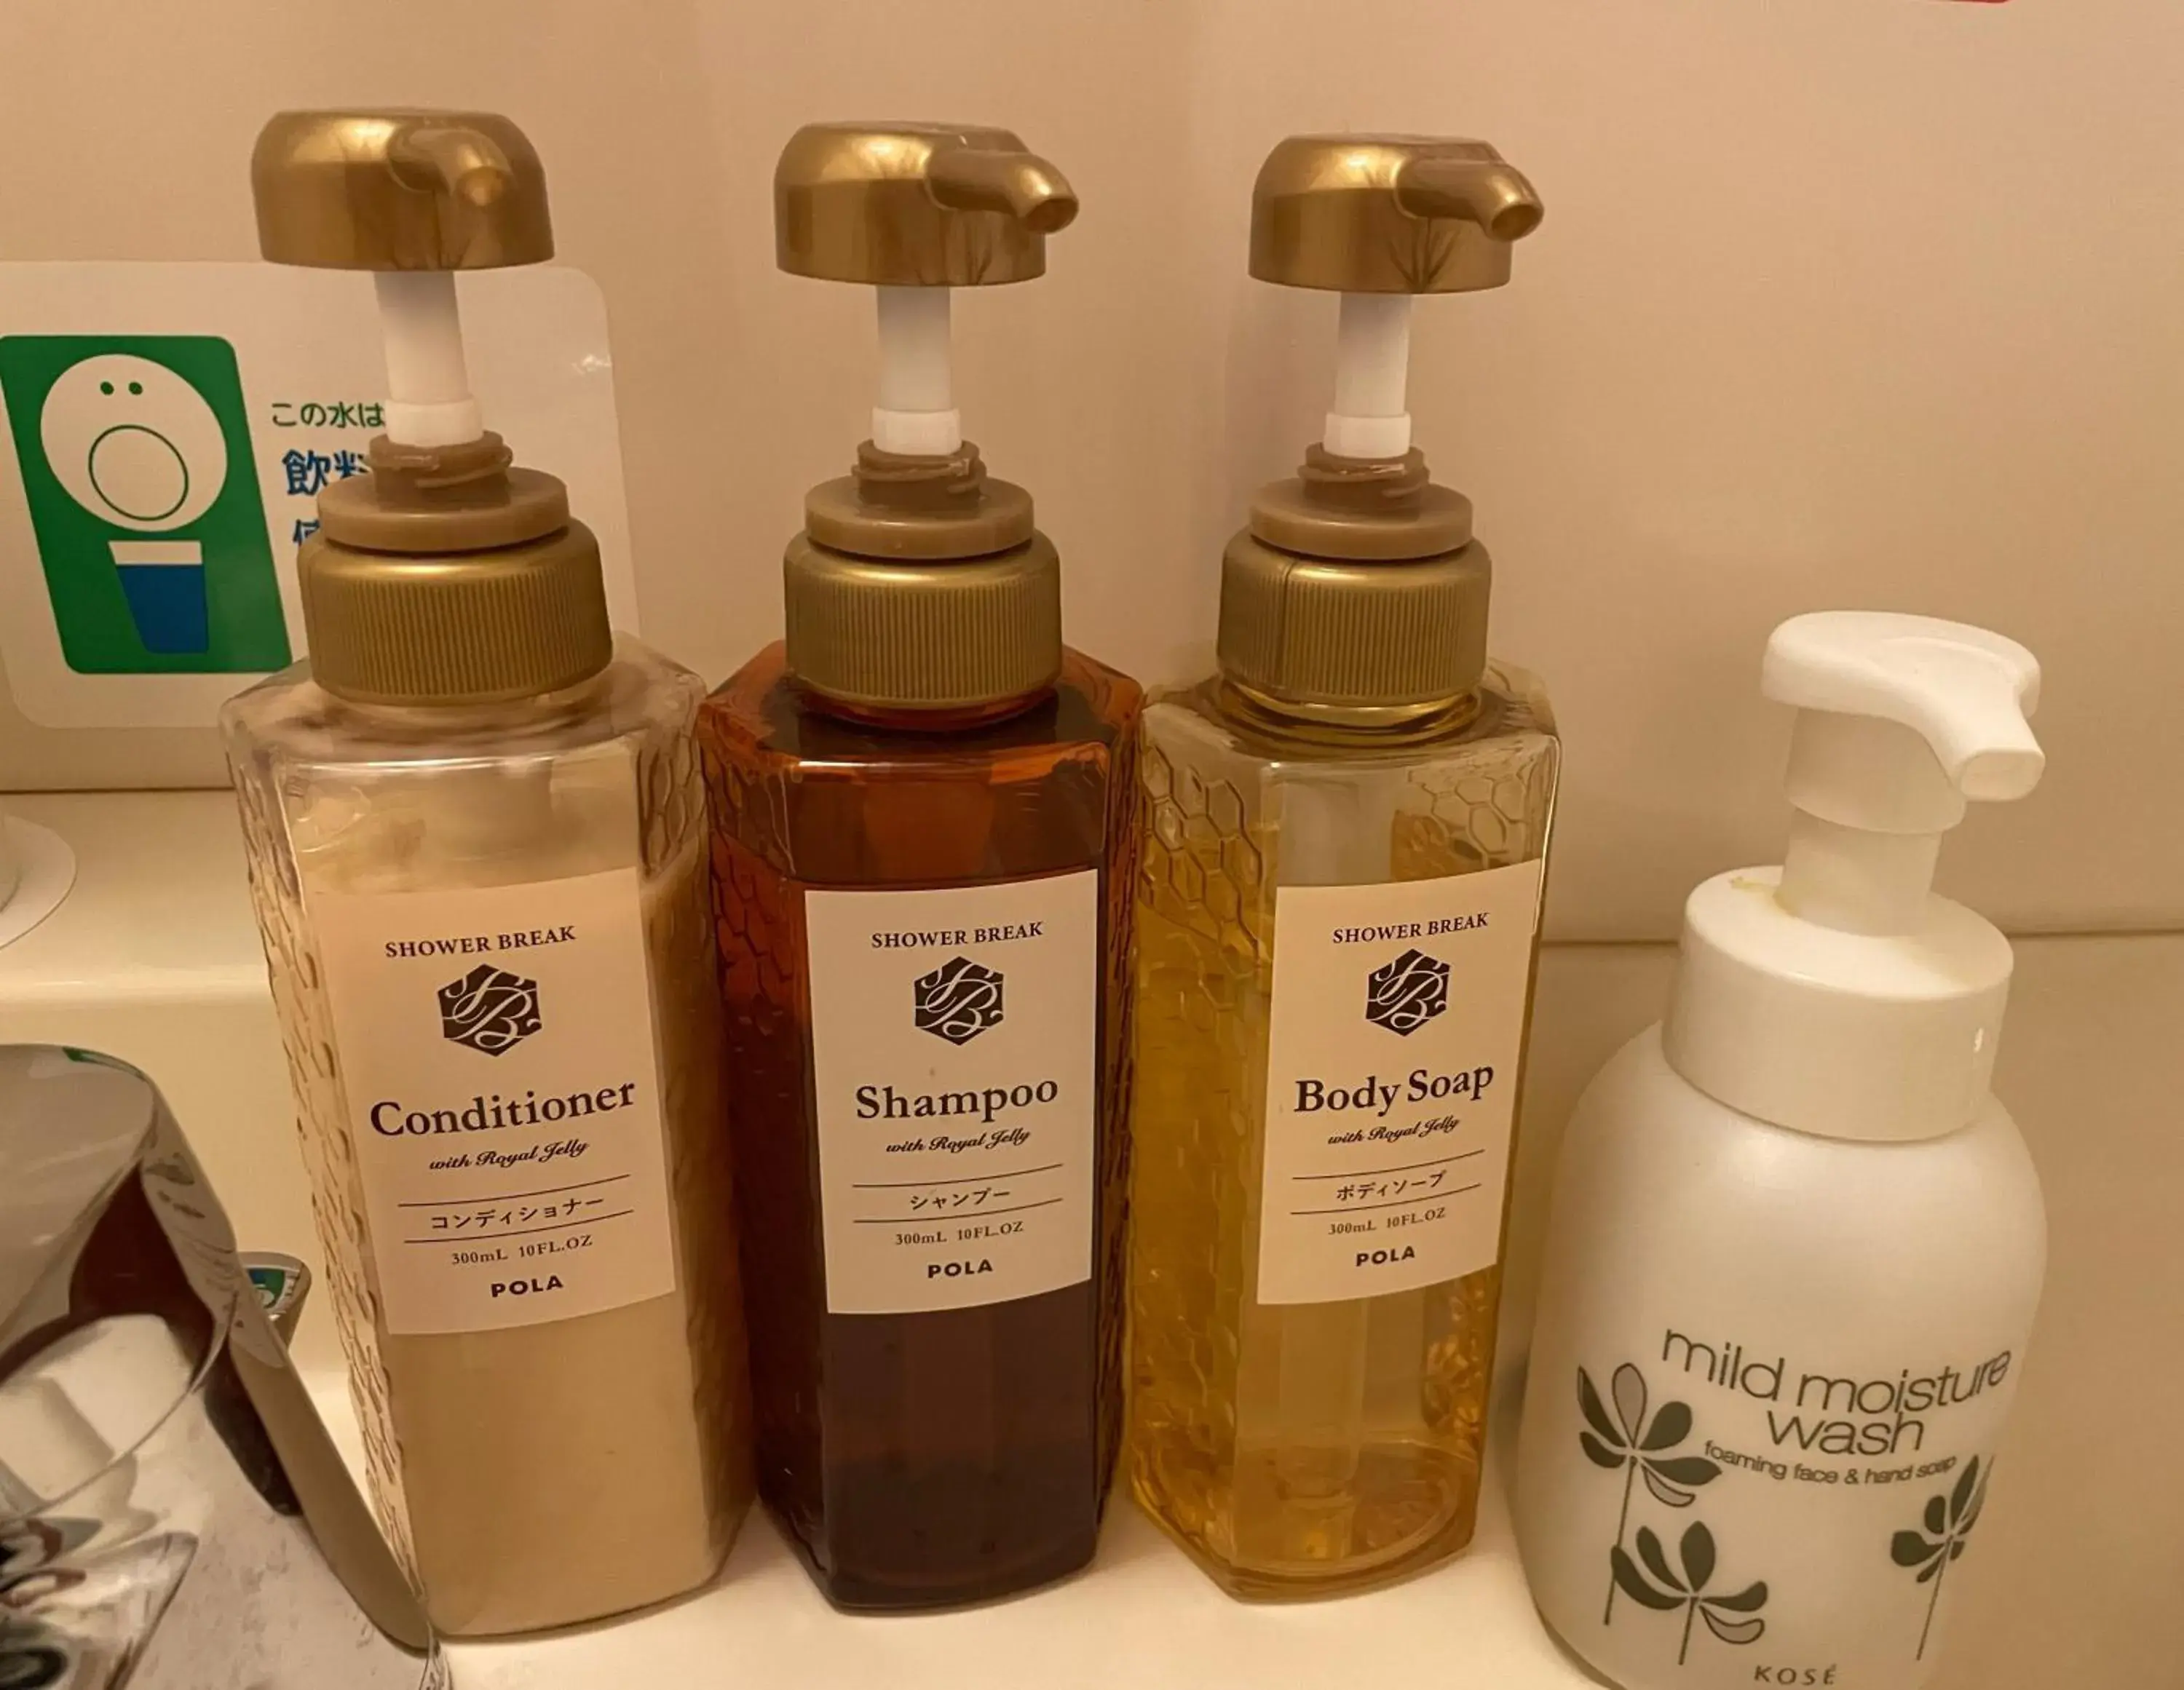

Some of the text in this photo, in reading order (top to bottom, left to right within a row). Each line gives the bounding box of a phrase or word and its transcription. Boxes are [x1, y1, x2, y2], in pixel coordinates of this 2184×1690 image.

[272, 401, 385, 429] この水は
[385, 925, 577, 958] SHOWER BREAK
[871, 921, 1044, 948] SHOWER BREAK
[1333, 912, 1490, 944] SHOWER BREAK
[855, 1079, 1059, 1123] Shampoo
[1294, 1066, 1494, 1116] Body Soap
[370, 1082, 636, 1137] Conditioner
[886, 1127, 1031, 1154] with Royal Jelly
[1328, 1116, 1460, 1145] with Royal Jelly
[429, 1139, 589, 1170] with Royal Jelly
[910, 1186, 1010, 1210] シャンプー
[1336, 1169, 1447, 1201] ボディソープ
[431, 1197, 604, 1230] コンディショナー
[1328, 1220, 1377, 1235] 300mL
[451, 1234, 593, 1266] 300mL 10FL.OZ
[895, 1231, 946, 1245] 300mL
[927, 1258, 993, 1279] POLA
[1356, 1245, 1415, 1267] POLA
[491, 1274, 564, 1298] POLA
[1662, 1329, 2012, 1414] mild moisture
[1767, 1411, 1925, 1456] wash
[1704, 1440, 1958, 1485] foaming face & hand soap
[1754, 1664, 1837, 1686] KOSÉ
